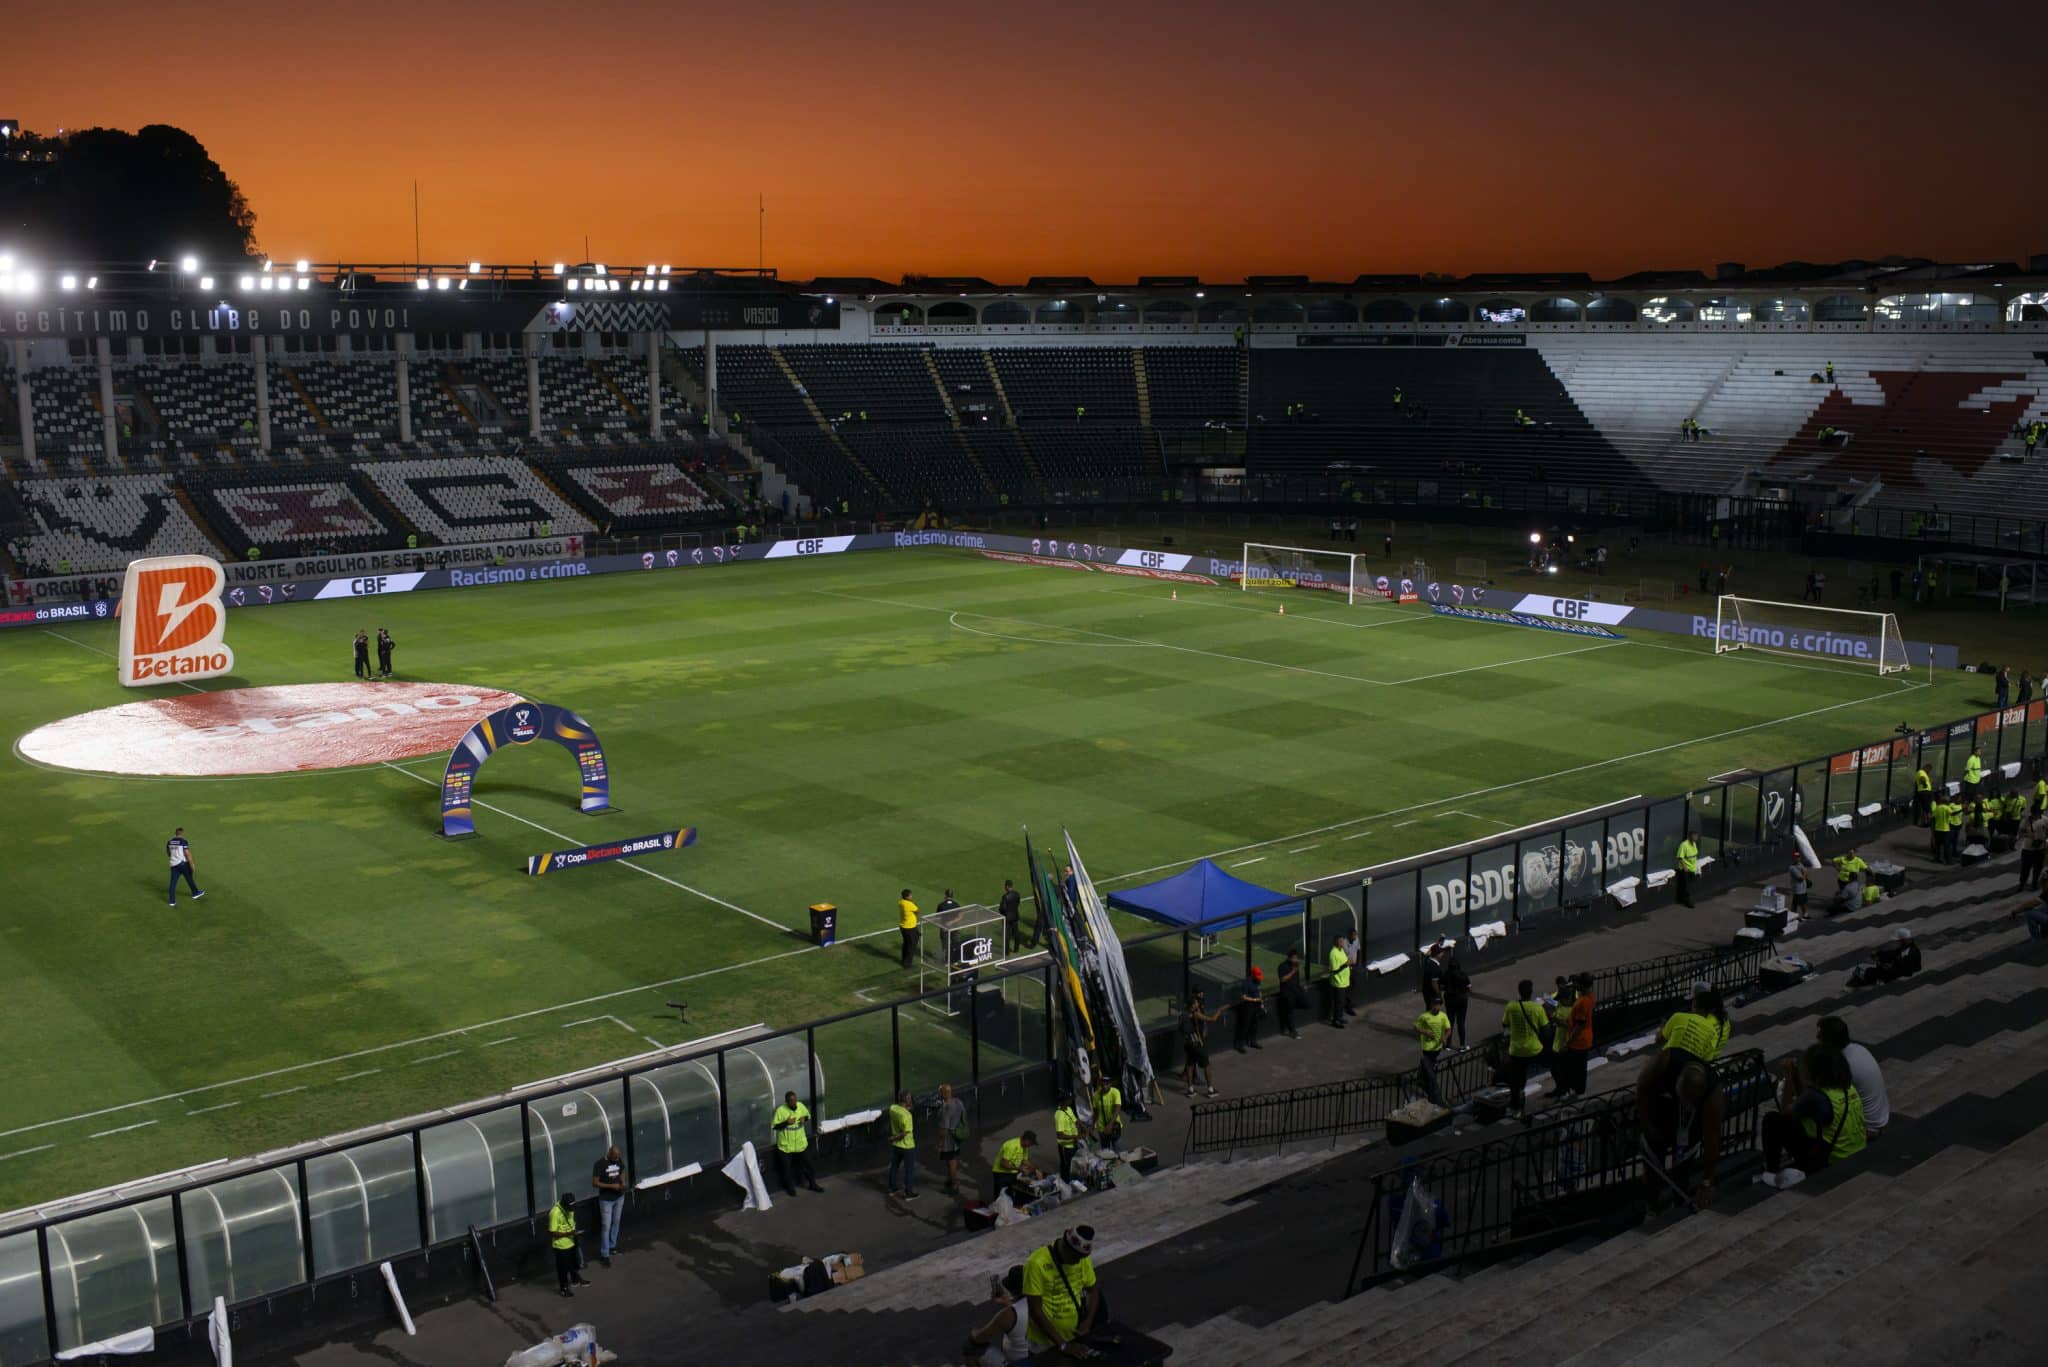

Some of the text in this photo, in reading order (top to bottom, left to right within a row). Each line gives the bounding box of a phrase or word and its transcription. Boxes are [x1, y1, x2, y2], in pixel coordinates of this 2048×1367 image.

[280, 309, 310, 330] DO
[331, 308, 409, 329] POVO!
[743, 306, 779, 325] VASCO
[1462, 335, 1481, 345] Abra
[1499, 336, 1522, 345] conta
[796, 538, 824, 554] CBF
[894, 529, 948, 547] Racismo
[955, 531, 986, 549] crime.
[295, 555, 367, 577] ORGULHO
[372, 554, 391, 569] DE
[519, 541, 562, 558] VASCO
[1140, 551, 1165, 569] CBF
[1210, 558, 1270, 580] Racimo
[451, 560, 591, 588] Racismo é crime.
[36, 577, 118, 598] ORGUHO
[352, 577, 387, 595] CBF
[36, 609, 49, 619] do
[50, 605, 89, 618] BRASIL
[1552, 599, 1590, 620] CBF
[1692, 615, 1873, 660] Racismo é crime.
[132, 653, 227, 680] Betano
[567, 853, 587, 864] Copa
[622, 844, 632, 853] do
[632, 838, 661, 851] BRASIL
[974, 938, 993, 956] cbf
[978, 952, 993, 962] VAR
